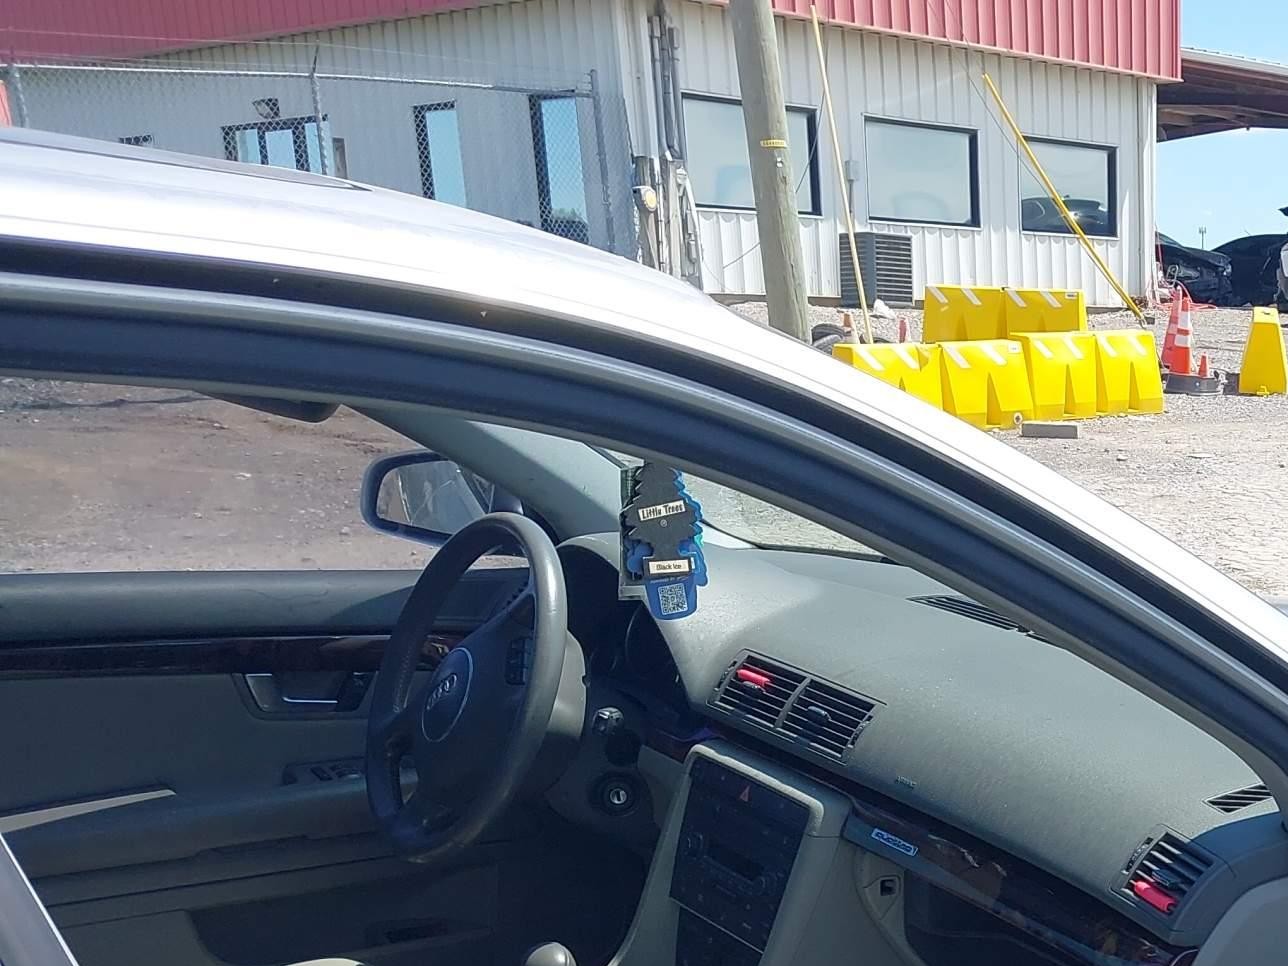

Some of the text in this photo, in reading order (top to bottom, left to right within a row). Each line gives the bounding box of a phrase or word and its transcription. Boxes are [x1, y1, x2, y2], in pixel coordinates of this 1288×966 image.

[641, 503, 684, 520] Little Trees
[656, 561, 682, 570] Black Ice
